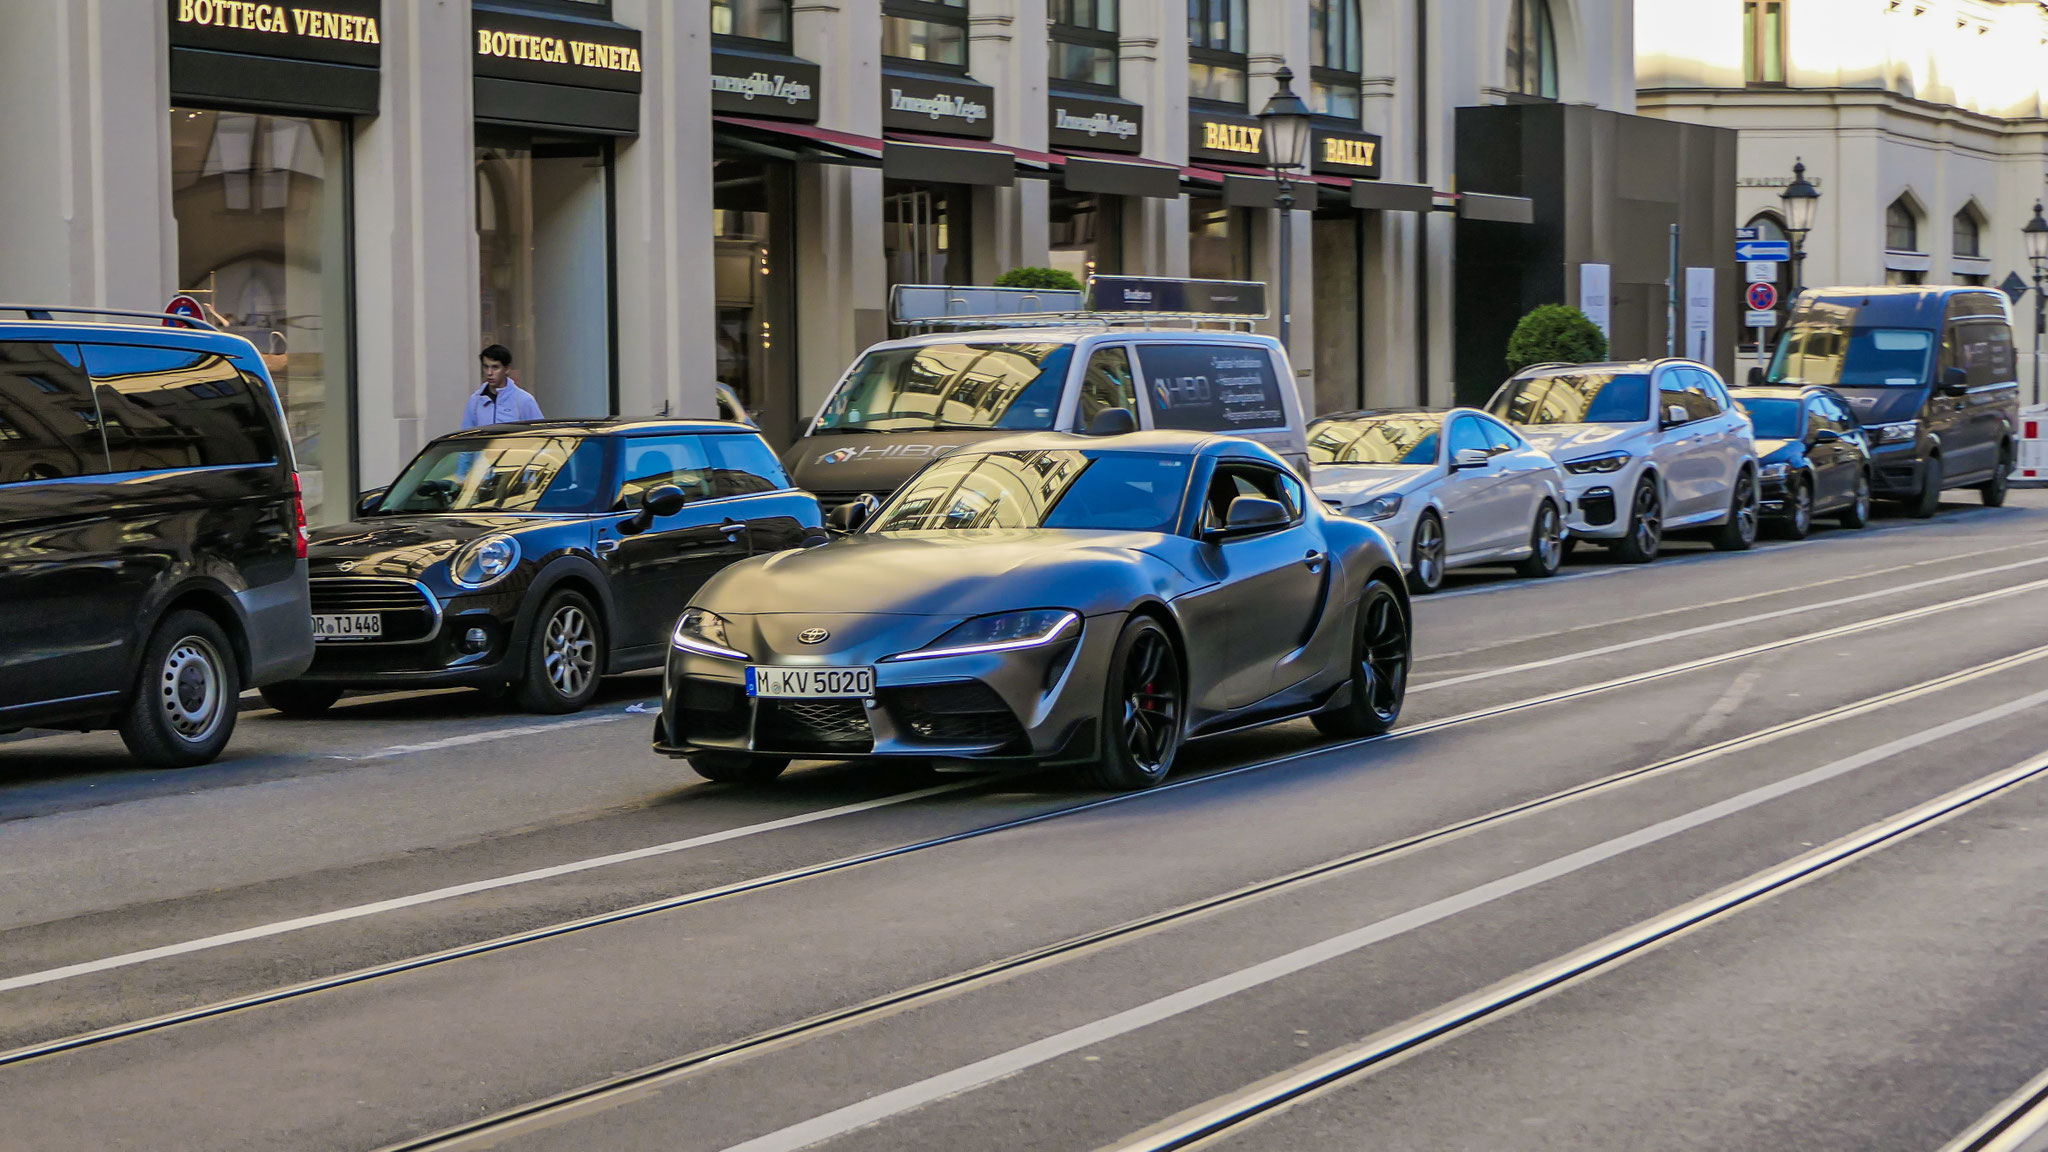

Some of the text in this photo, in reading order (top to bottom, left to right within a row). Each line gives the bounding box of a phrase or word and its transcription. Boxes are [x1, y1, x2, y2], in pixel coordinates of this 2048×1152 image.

[178, 0, 380, 44] BOTTEGA VENETA
[478, 30, 642, 72] BOTTEGA VENETA
[1205, 122, 1262, 153] BALLY
[1325, 138, 1375, 166] BALLY
[334, 616, 352, 633] TJ
[355, 616, 380, 633] 448
[757, 671, 870, 694] M KV 5020
